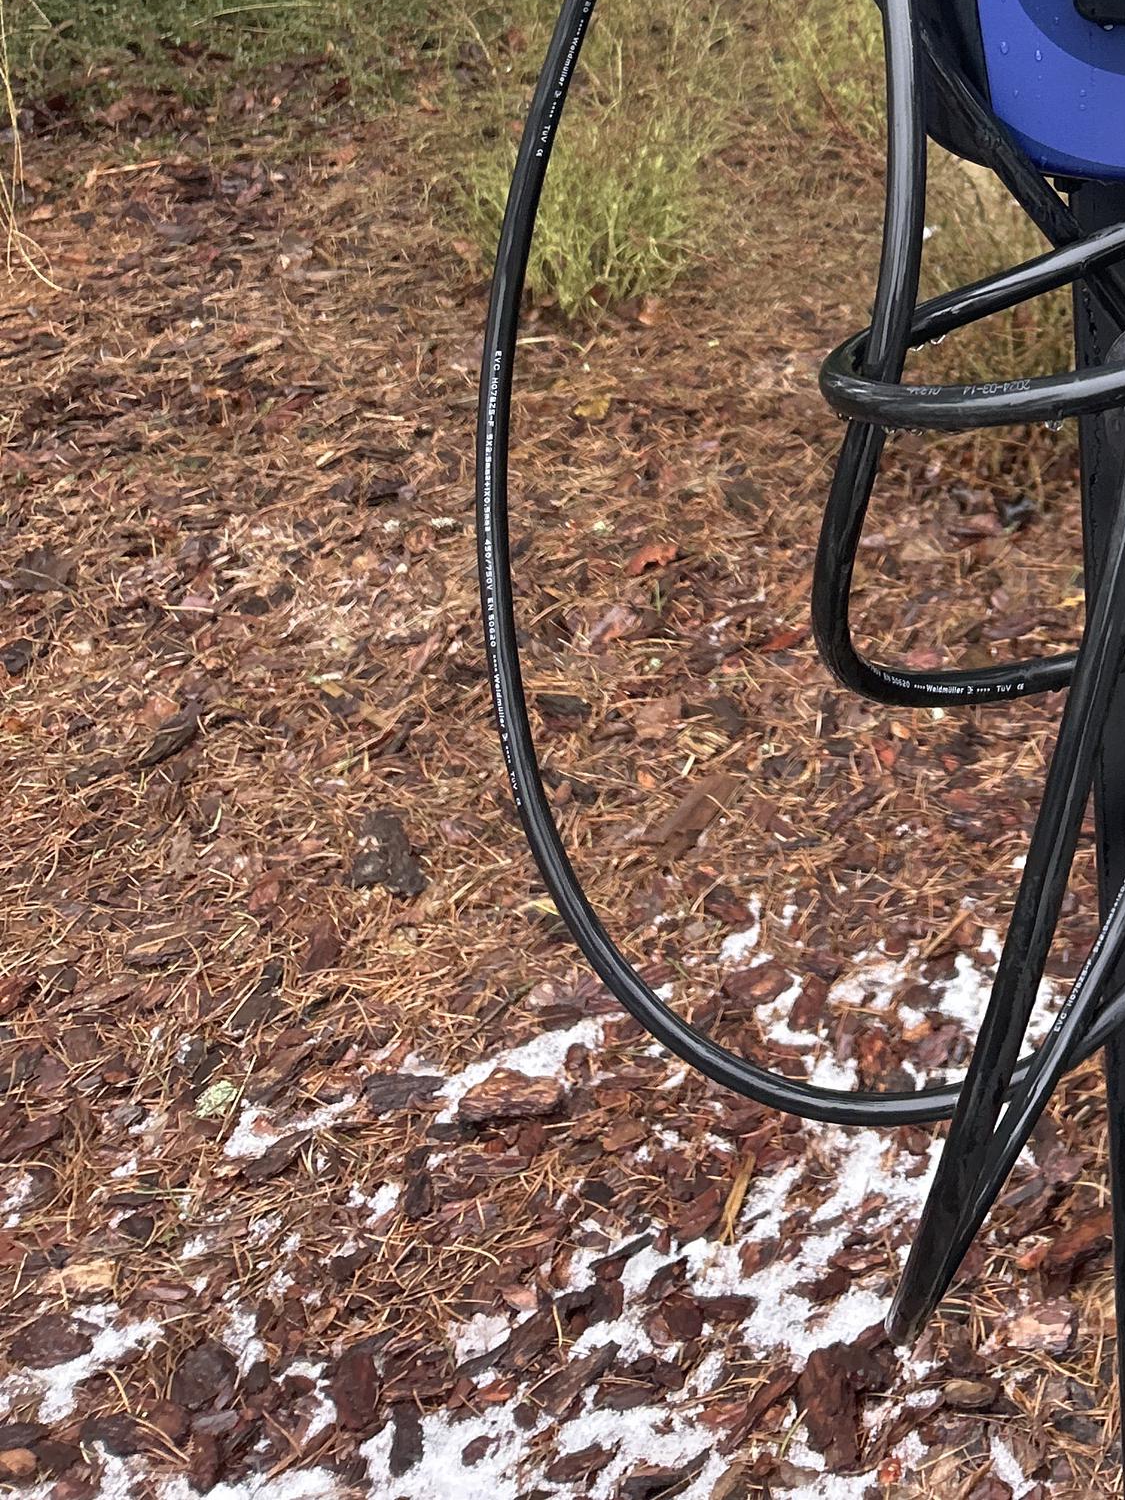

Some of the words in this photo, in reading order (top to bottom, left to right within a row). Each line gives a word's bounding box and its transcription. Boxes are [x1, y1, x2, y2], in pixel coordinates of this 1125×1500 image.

[493, 350, 503, 371] EVC
[484, 538, 494, 591] 450/750V
[487, 597, 495, 612] EN
[488, 613, 497, 648] 50620
[1053, 1012, 1067, 1033] EVC
